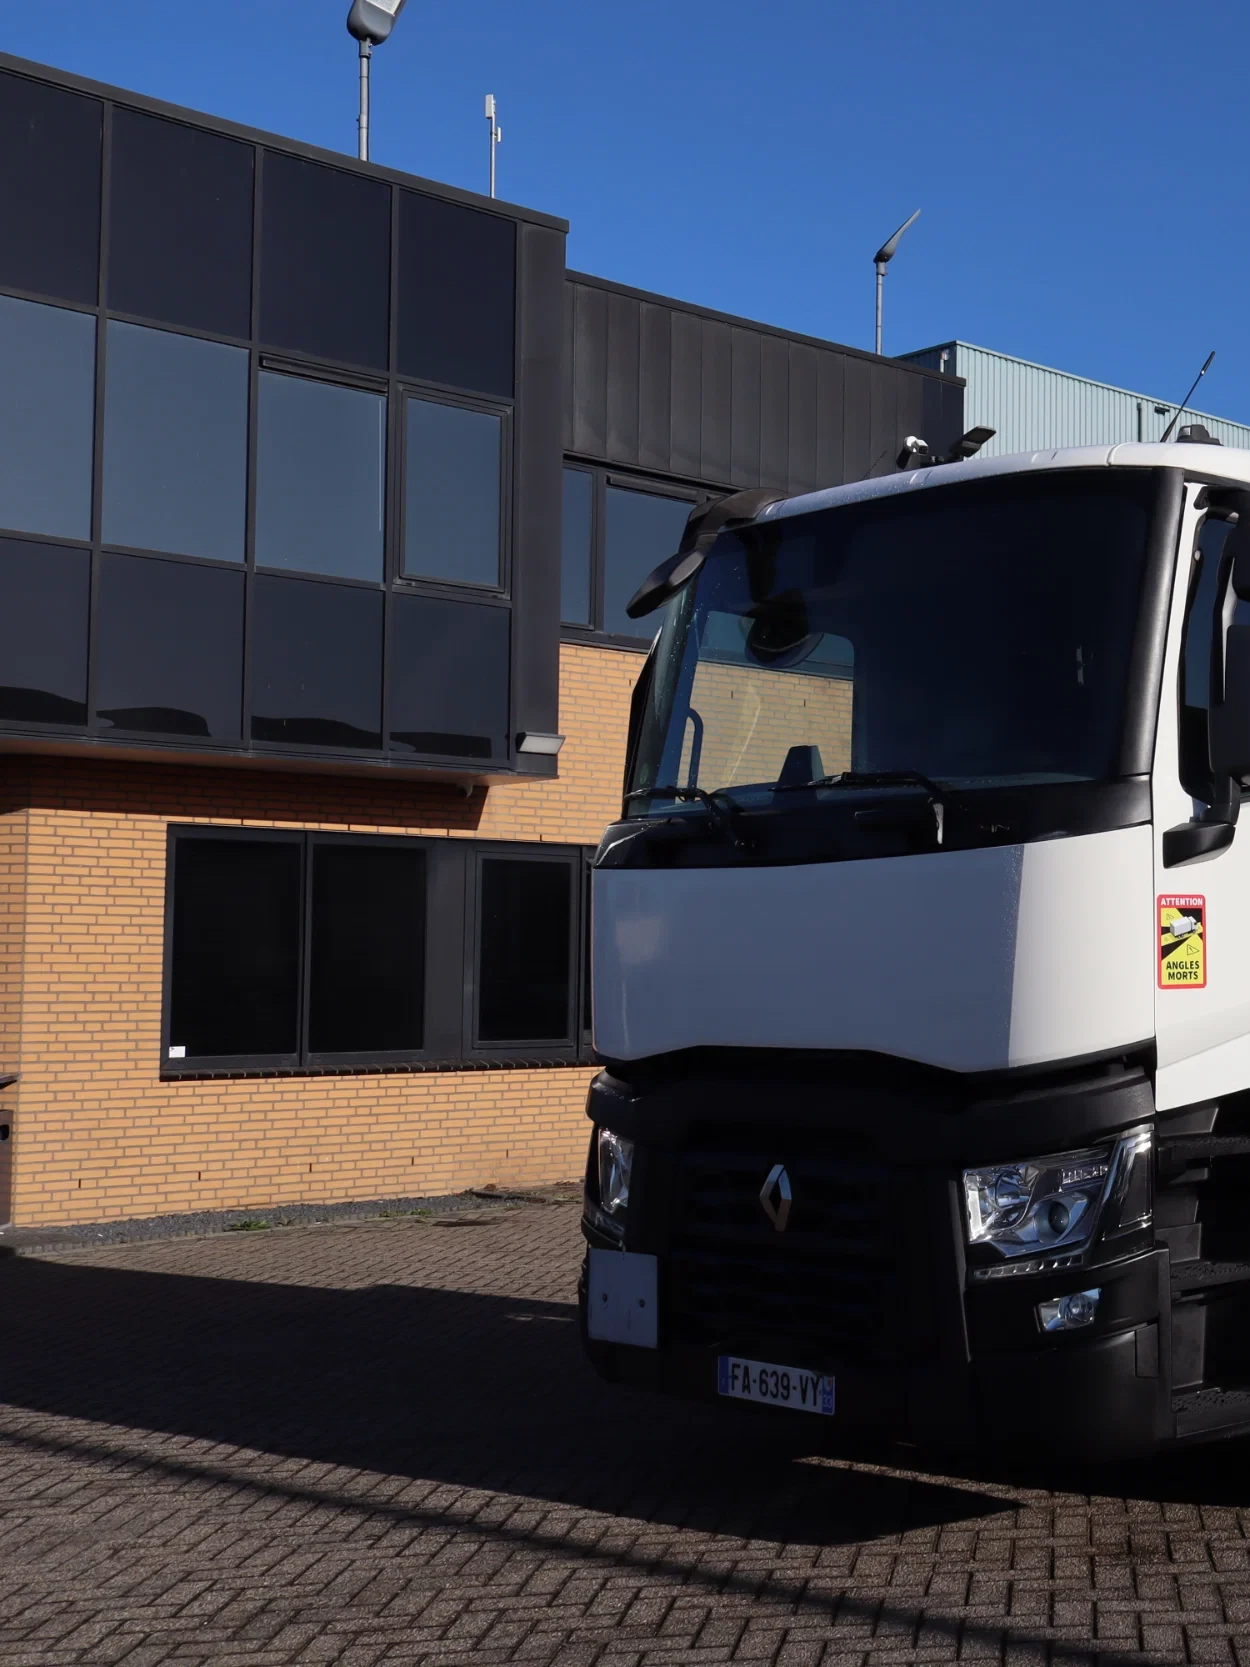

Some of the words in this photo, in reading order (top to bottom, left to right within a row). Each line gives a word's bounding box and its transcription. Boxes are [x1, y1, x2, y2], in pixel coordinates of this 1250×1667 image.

[1160, 897, 1203, 906] ATTENTION
[1165, 961, 1200, 970] ANGLES
[1167, 971, 1199, 980] MORTS
[731, 1362, 823, 1407] FA-639-VY
